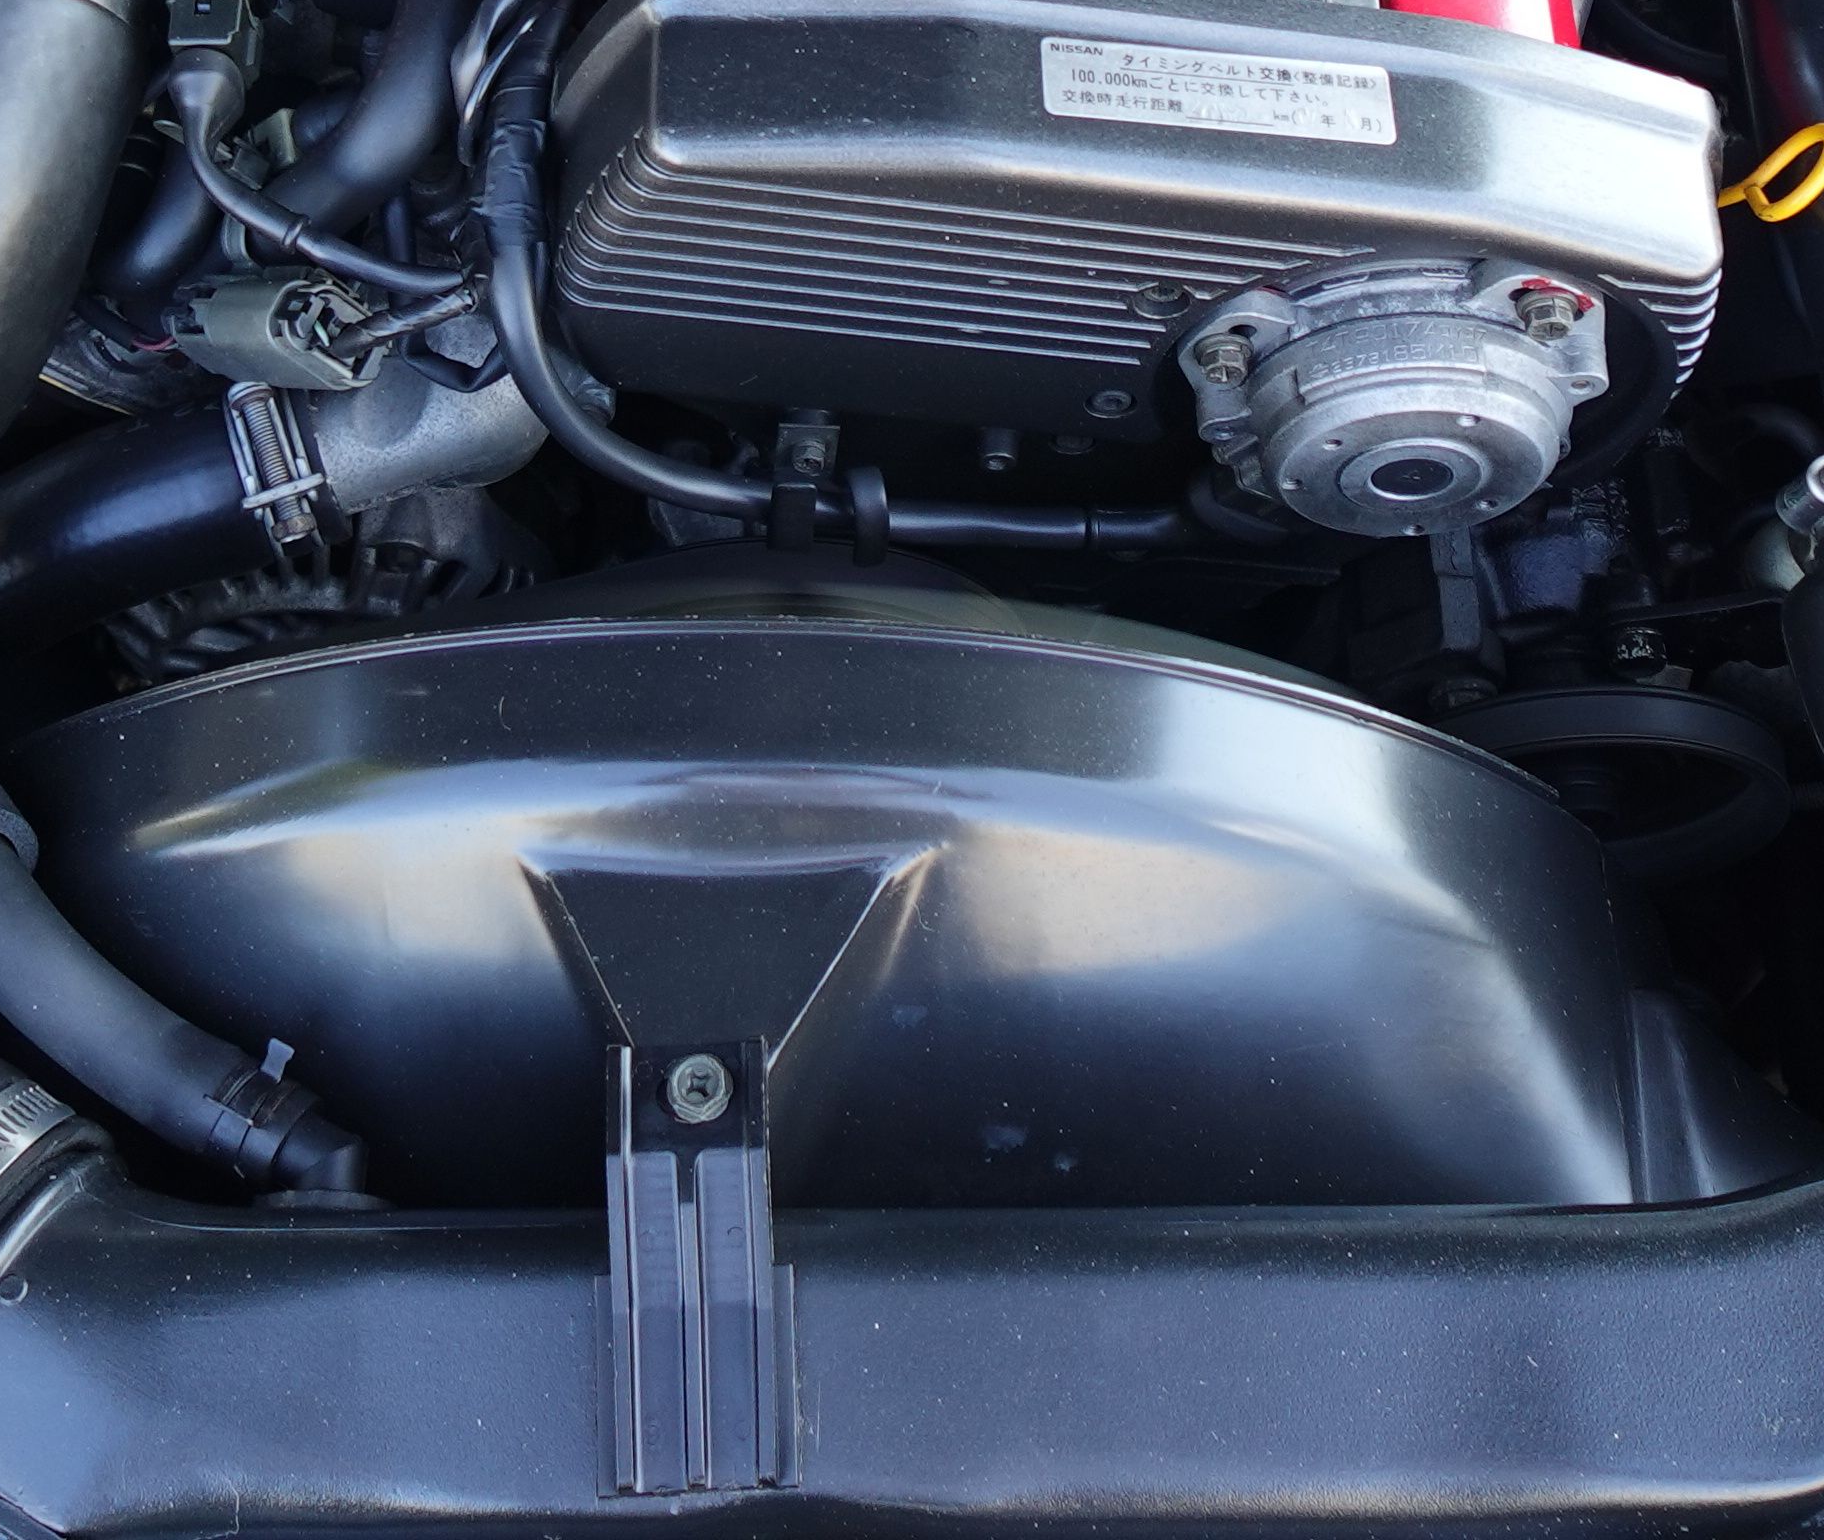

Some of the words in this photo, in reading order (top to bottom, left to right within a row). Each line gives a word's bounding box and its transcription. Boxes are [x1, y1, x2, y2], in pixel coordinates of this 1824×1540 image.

[1049, 42, 1104, 57] NISSAN
[1061, 89, 1184, 114] 交換時走行距離
